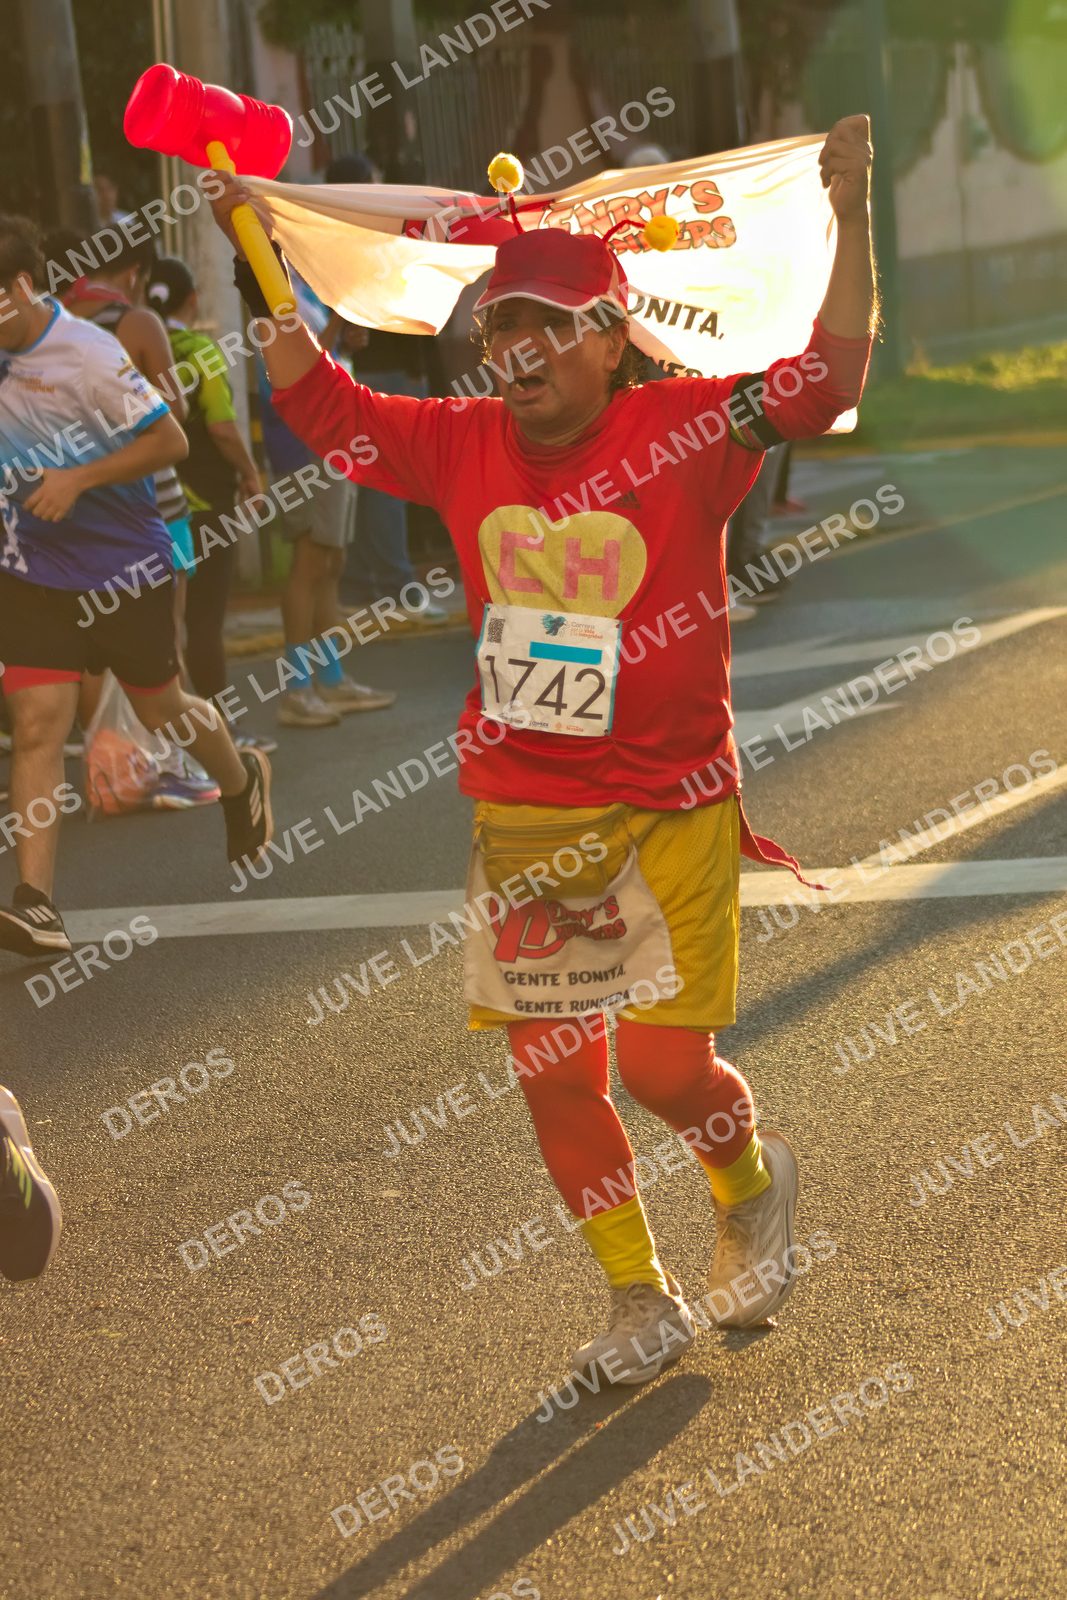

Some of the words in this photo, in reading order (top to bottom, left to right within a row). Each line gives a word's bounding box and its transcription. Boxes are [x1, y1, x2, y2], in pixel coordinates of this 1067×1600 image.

[484, 655, 606, 720] 1742
[503, 971, 560, 986] GENTE
[514, 1000, 564, 1013] GENTE
